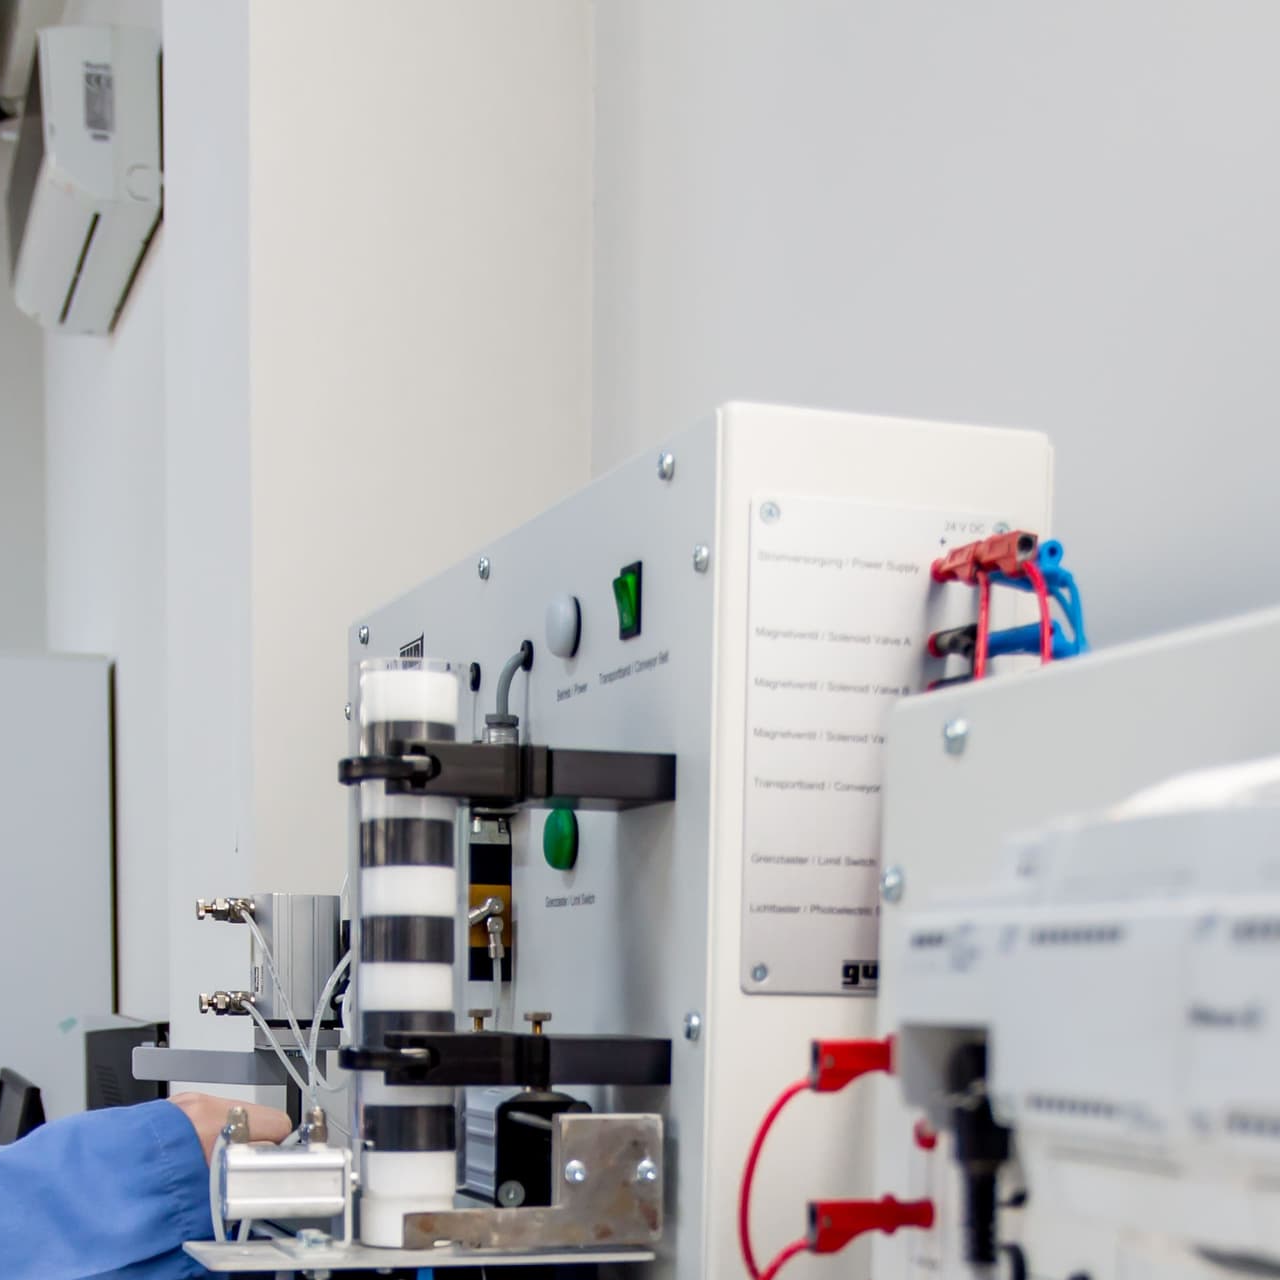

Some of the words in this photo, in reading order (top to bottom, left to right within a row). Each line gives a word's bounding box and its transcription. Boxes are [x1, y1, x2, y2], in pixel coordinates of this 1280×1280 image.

[852, 557, 883, 570] Power
[886, 559, 921, 575] Supply
[841, 962, 879, 986] gu
